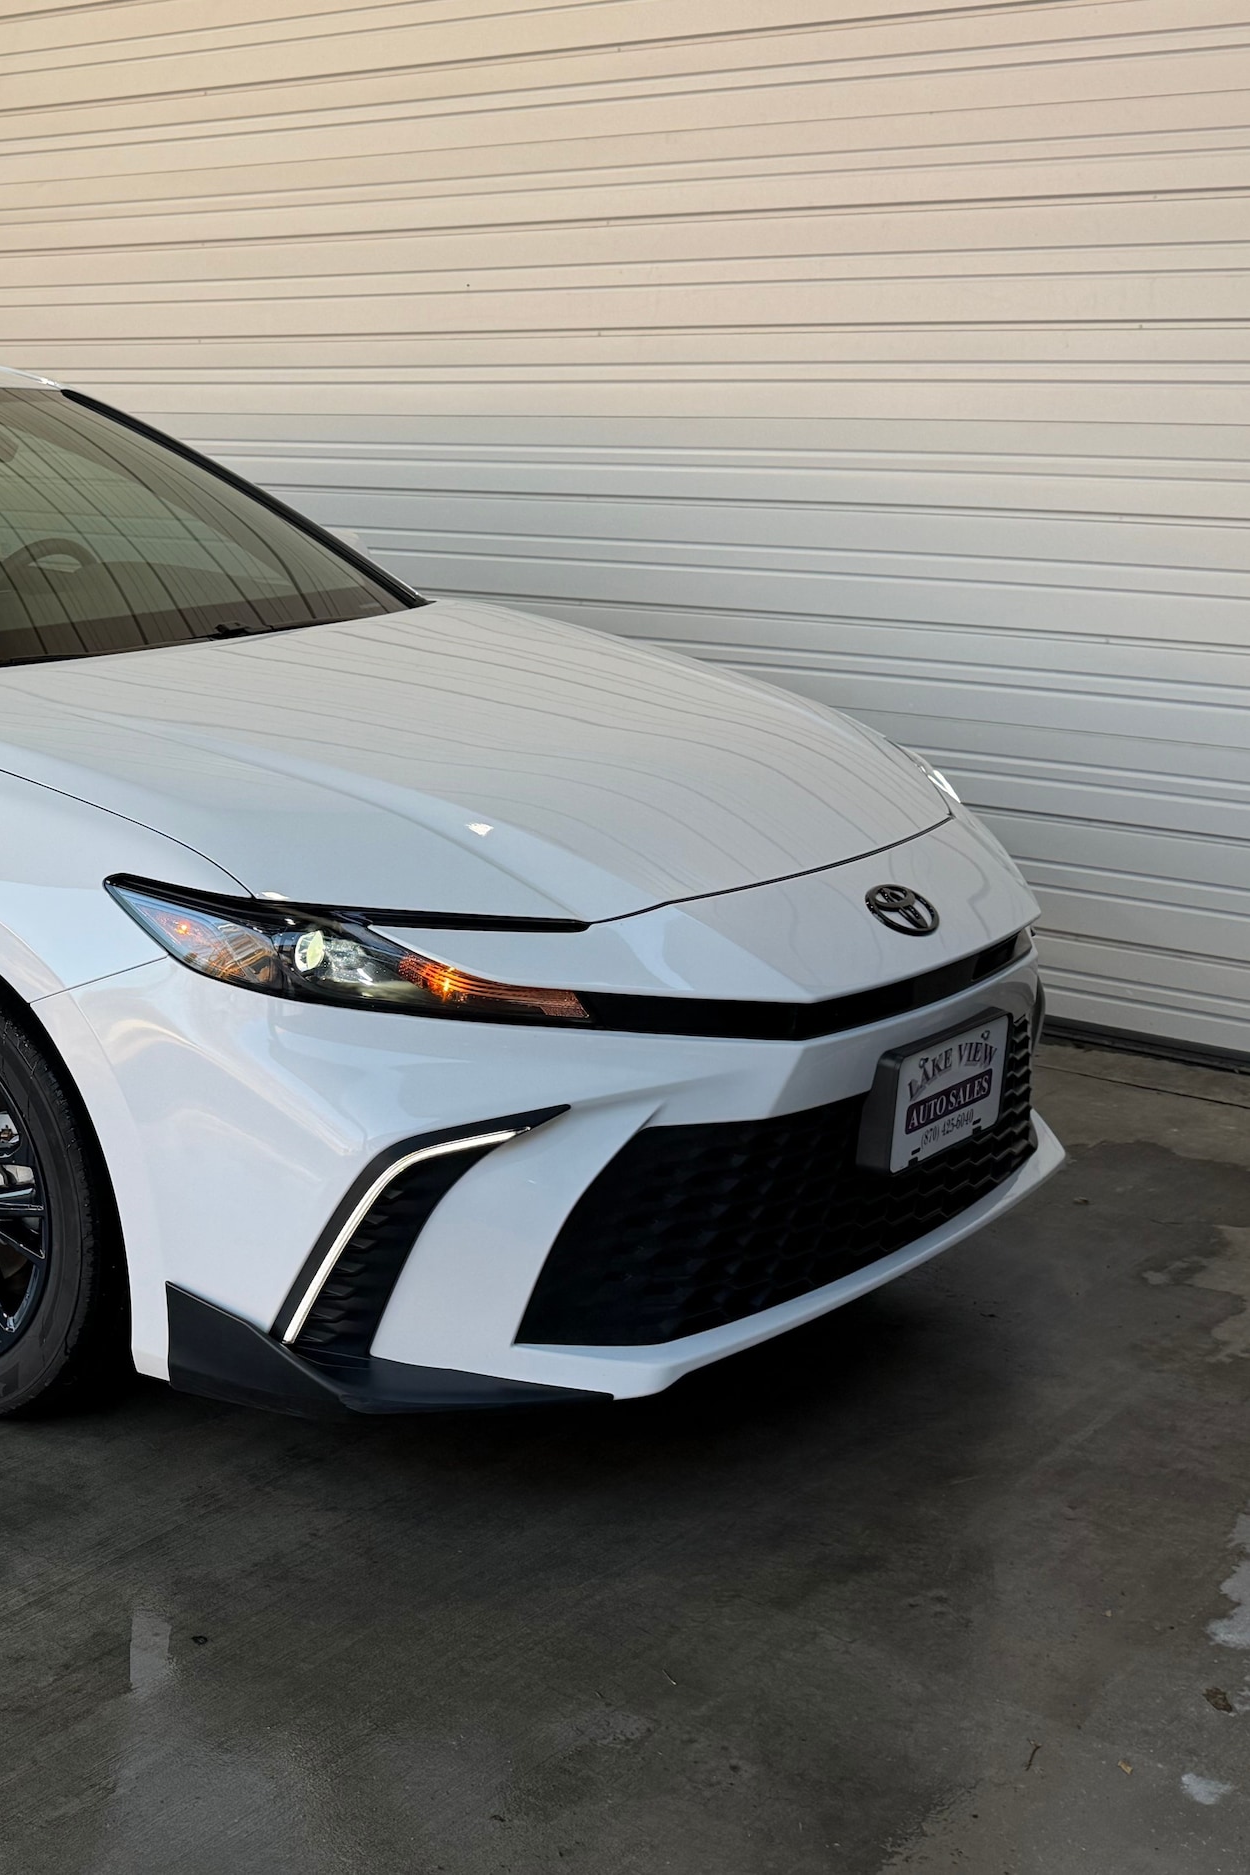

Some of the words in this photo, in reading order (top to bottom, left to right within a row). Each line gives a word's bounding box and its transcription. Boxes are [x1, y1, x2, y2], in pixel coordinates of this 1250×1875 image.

[907, 1048, 953, 1099] LAKE
[958, 1041, 998, 1067] VIEW
[909, 1095, 947, 1129] AUTO
[948, 1075, 990, 1110] SALES
[920, 1125, 941, 1149] (870)
